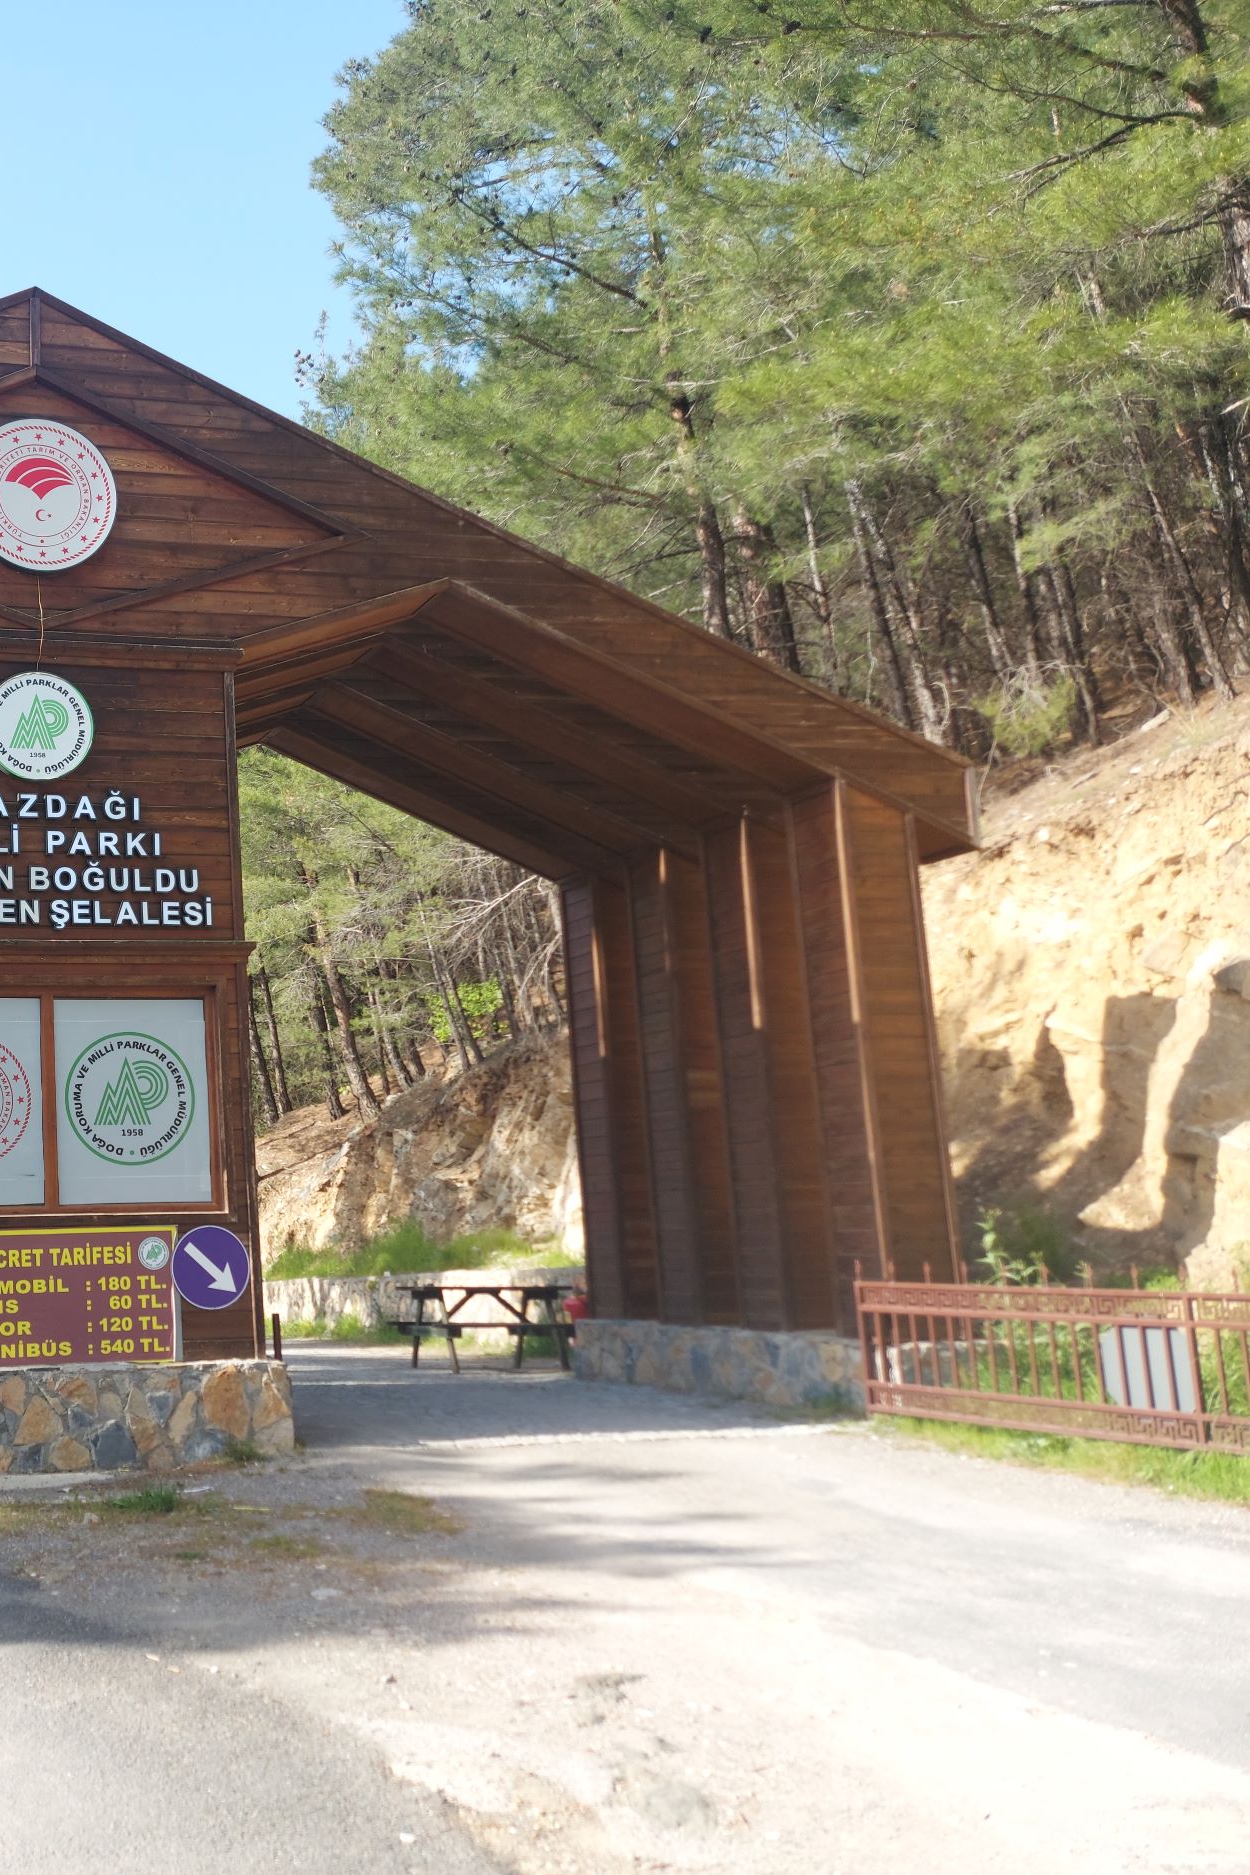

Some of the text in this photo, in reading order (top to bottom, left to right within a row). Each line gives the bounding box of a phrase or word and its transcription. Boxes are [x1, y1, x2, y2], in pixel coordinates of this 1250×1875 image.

[27, 447, 55, 456] TARIM
[58, 453, 69, 463] VE
[70, 464, 89, 494] ORMAN
[1, 680, 24, 700] MİLLİ
[26, 678, 70, 698] PARKLAR
[68, 696, 85, 727] GENEL
[44, 729, 86, 774] MÜDÜRLÜĞÜ
[7, 754, 32, 772] DOĞA
[46, 830, 161, 856] PARKI
[29, 860, 200, 894] BOĞULDU
[50, 896, 213, 930] ŞELALESİ
[73, 1040, 188, 1157] DOĞA KORUMA VE MİLLİ PARKLAR GENEL MÜDÜRLÜĞÜ
[121, 1128, 144, 1136] 1958
[48, 1241, 132, 1266] TARİFESİ
[98, 1276, 132, 1290] 180
[136, 1275, 167, 1290] TL.
[110, 1295, 132, 1310] 60
[138, 1294, 168, 1309] TL.
[99, 1317, 132, 1332] 120
[138, 1316, 168, 1330] TL.
[100, 1338, 134, 1354] 540
[140, 1338, 170, 1352] TL.
